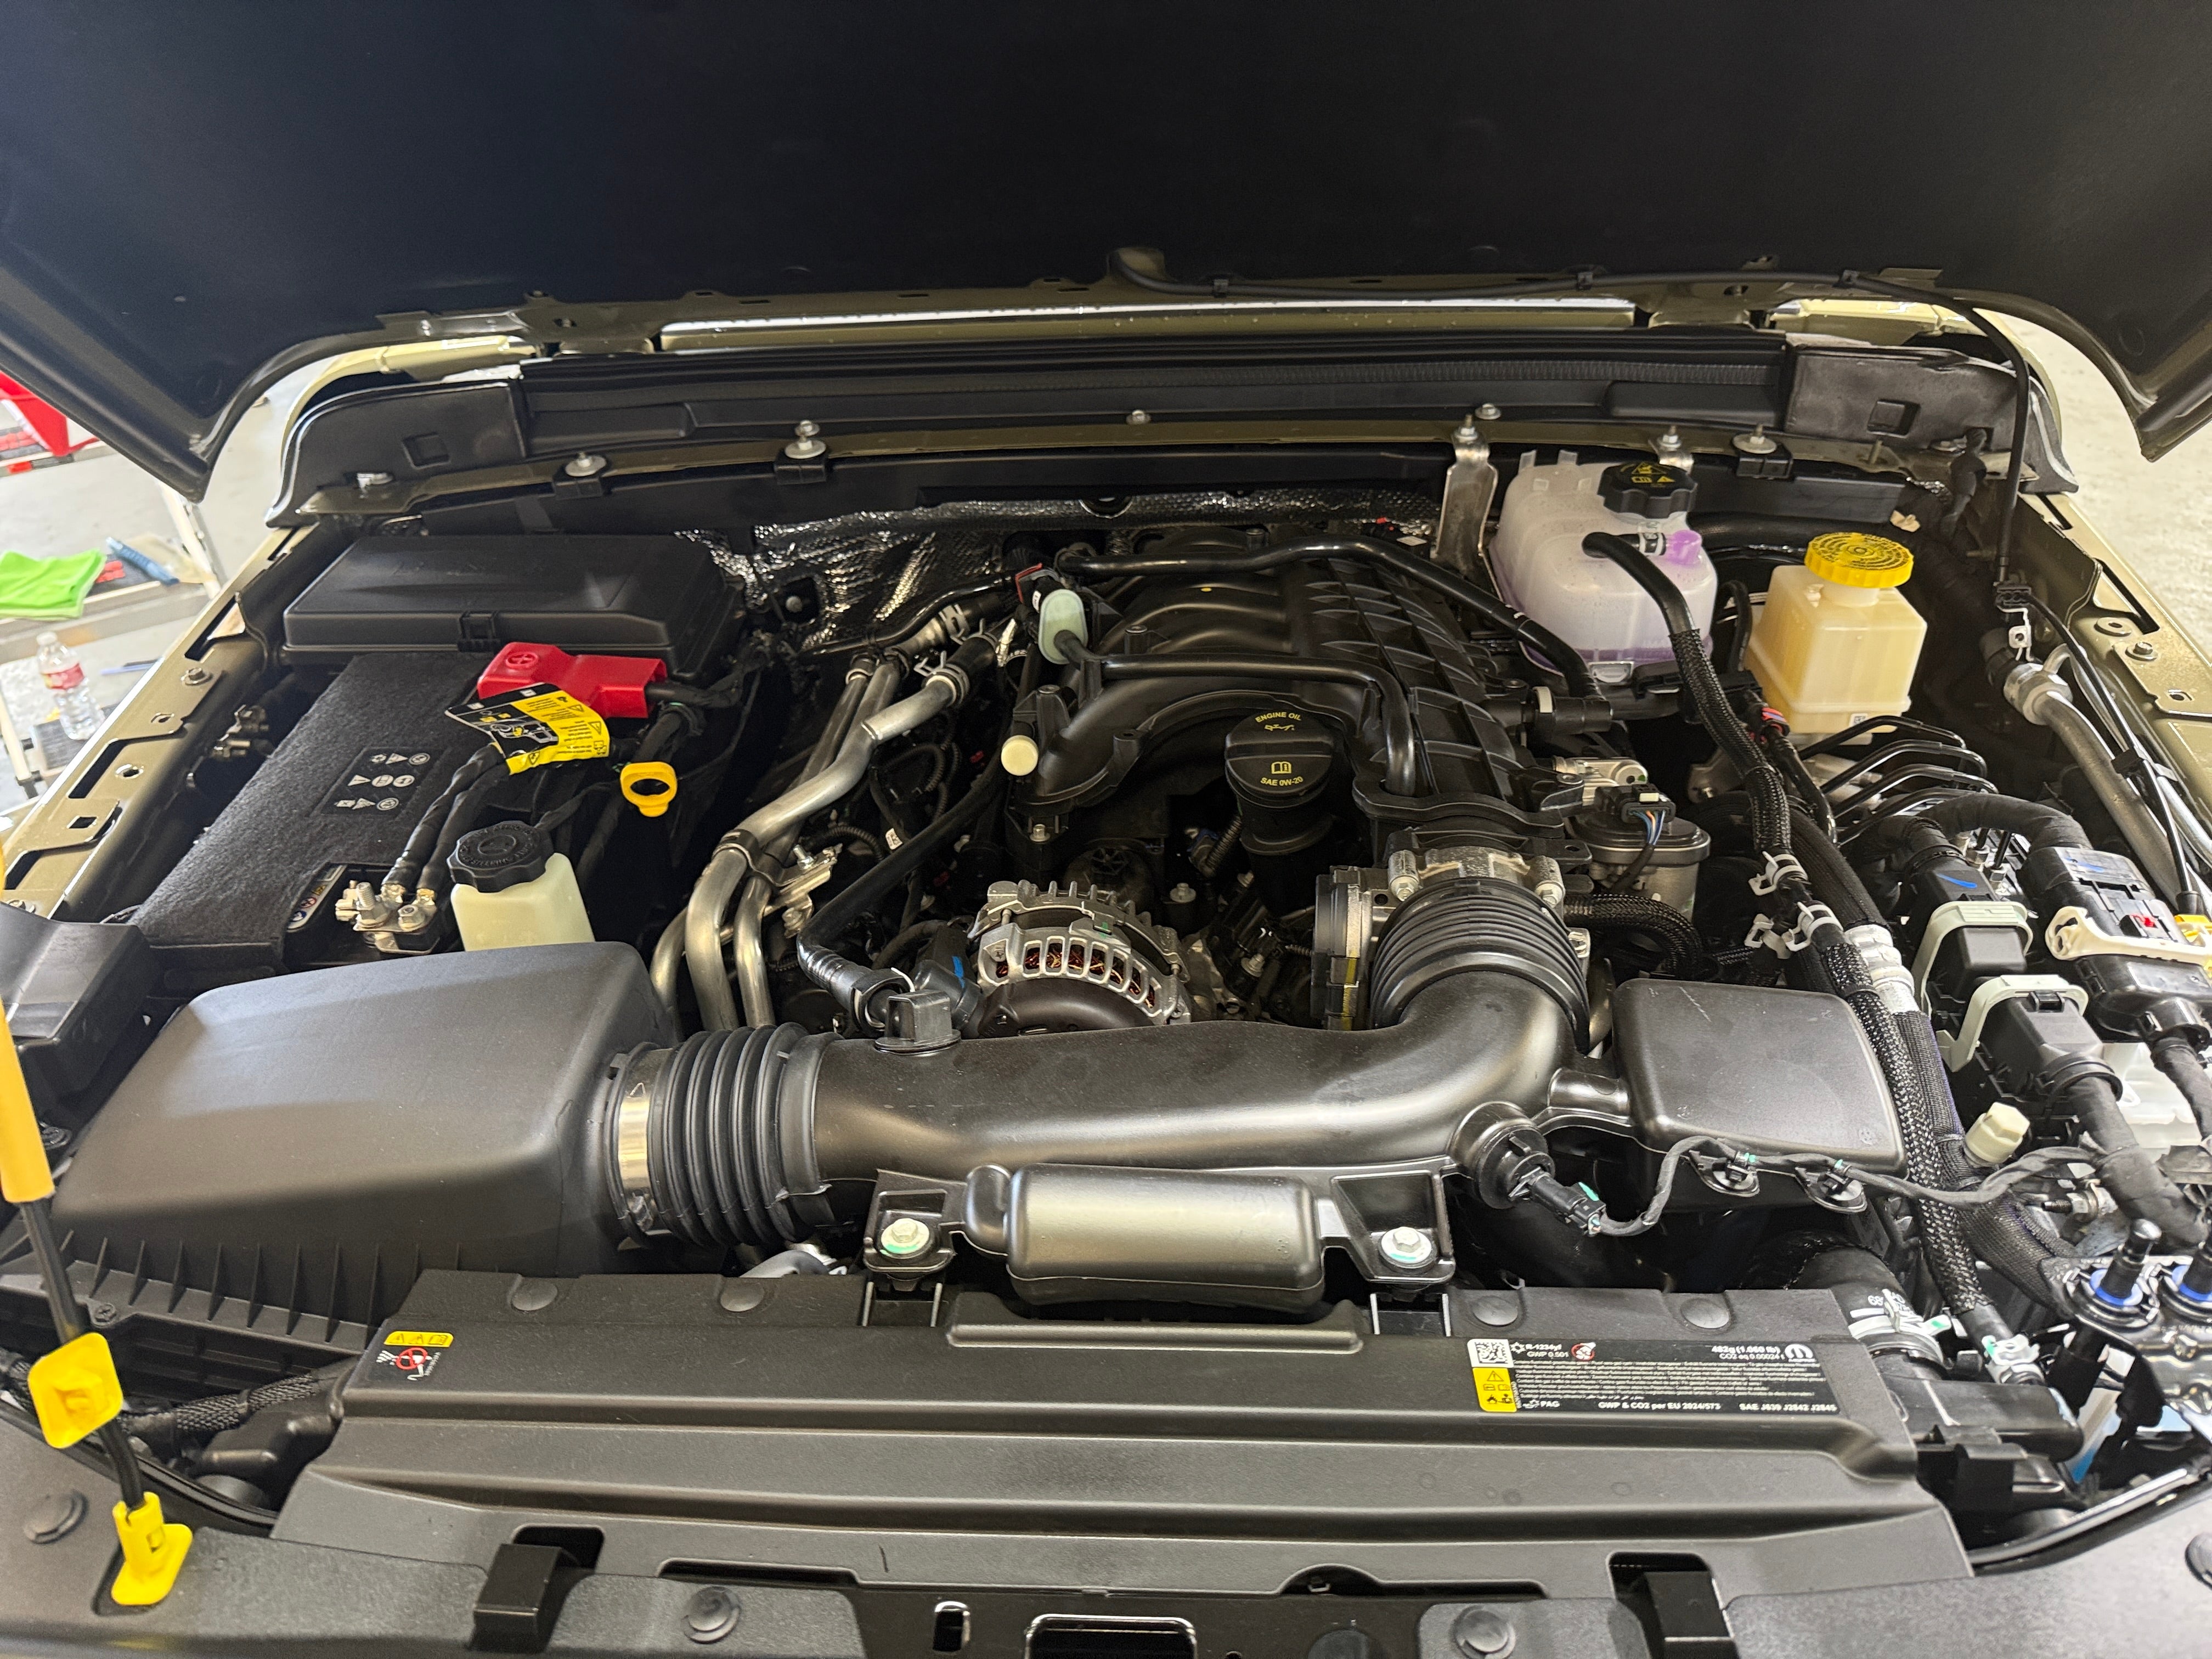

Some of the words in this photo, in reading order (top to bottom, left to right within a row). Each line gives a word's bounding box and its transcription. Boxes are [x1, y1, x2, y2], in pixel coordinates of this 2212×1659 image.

[1255, 712, 1287, 723] ENGINE
[1260, 777, 1278, 786] SAE
[1279, 776, 1304, 786] 0W-20
